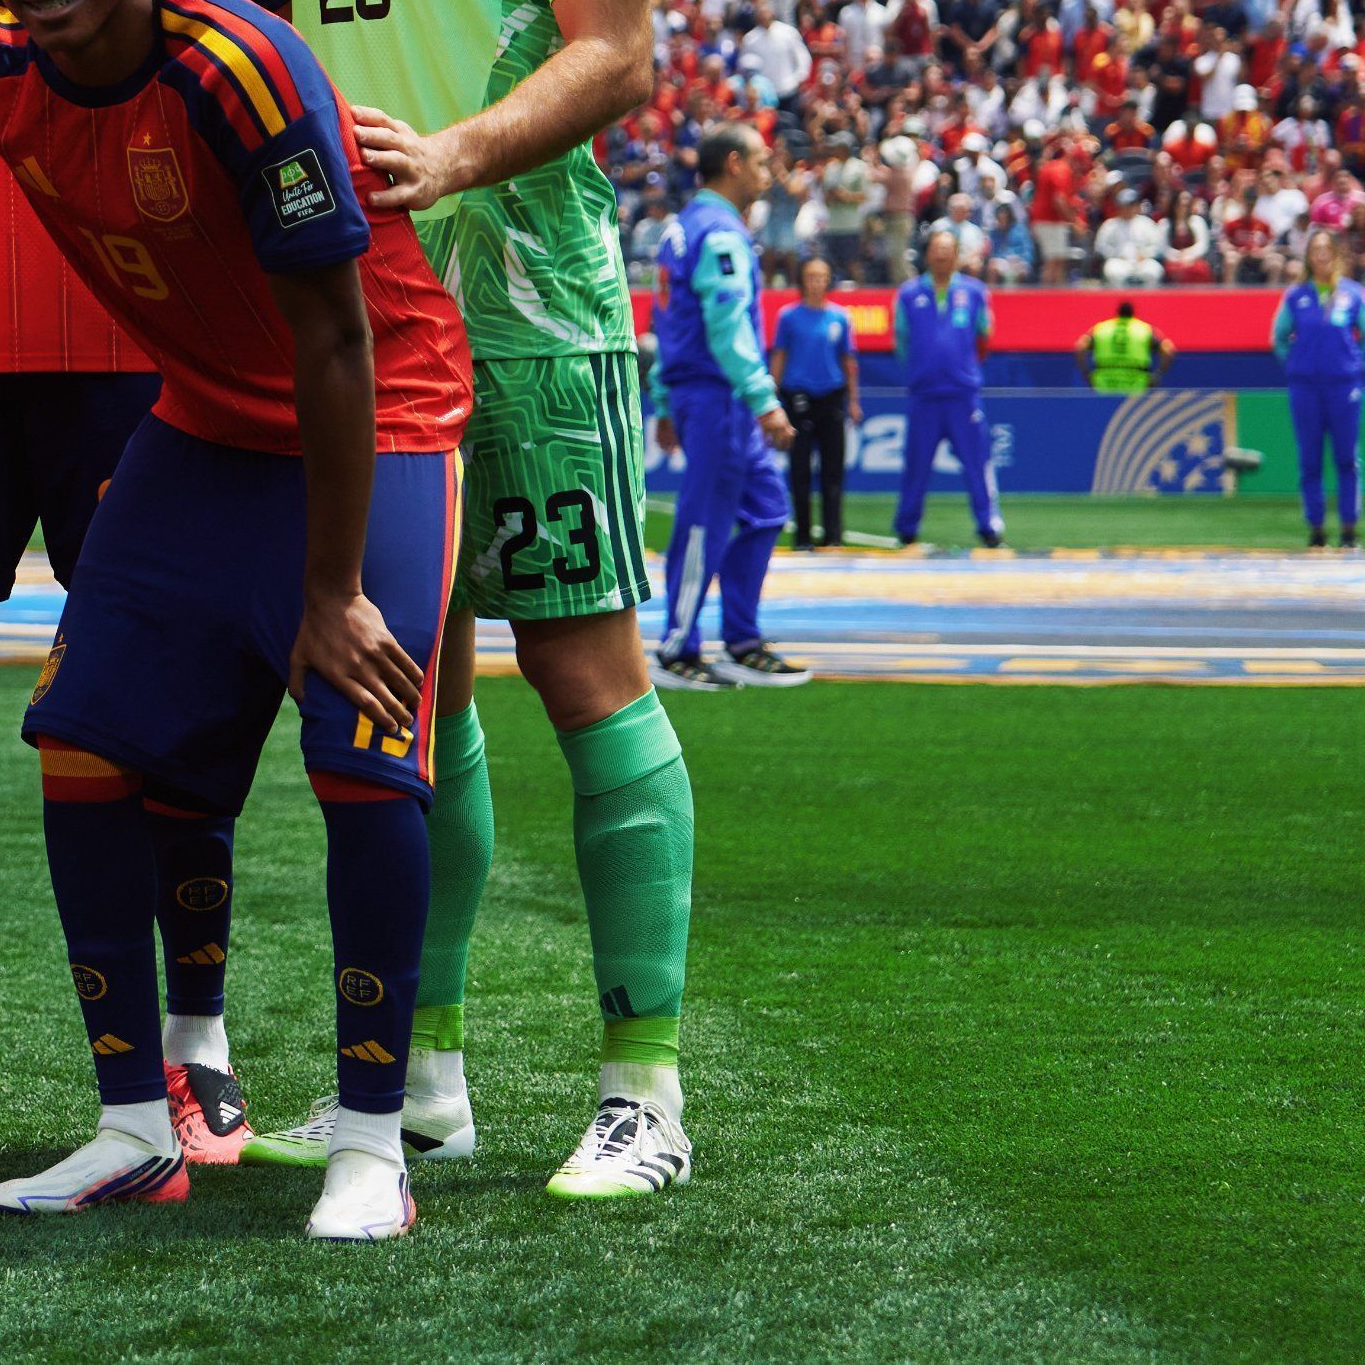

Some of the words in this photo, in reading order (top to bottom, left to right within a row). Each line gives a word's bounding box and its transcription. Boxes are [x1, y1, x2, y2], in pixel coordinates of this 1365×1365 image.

[281, 190, 325, 216] EDUCATION
[282, 187, 303, 202] Unite
[301, 181, 314, 195] For
[297, 207, 315, 218] FIFA
[78, 225, 171, 302] 19
[493, 489, 600, 591] 23
